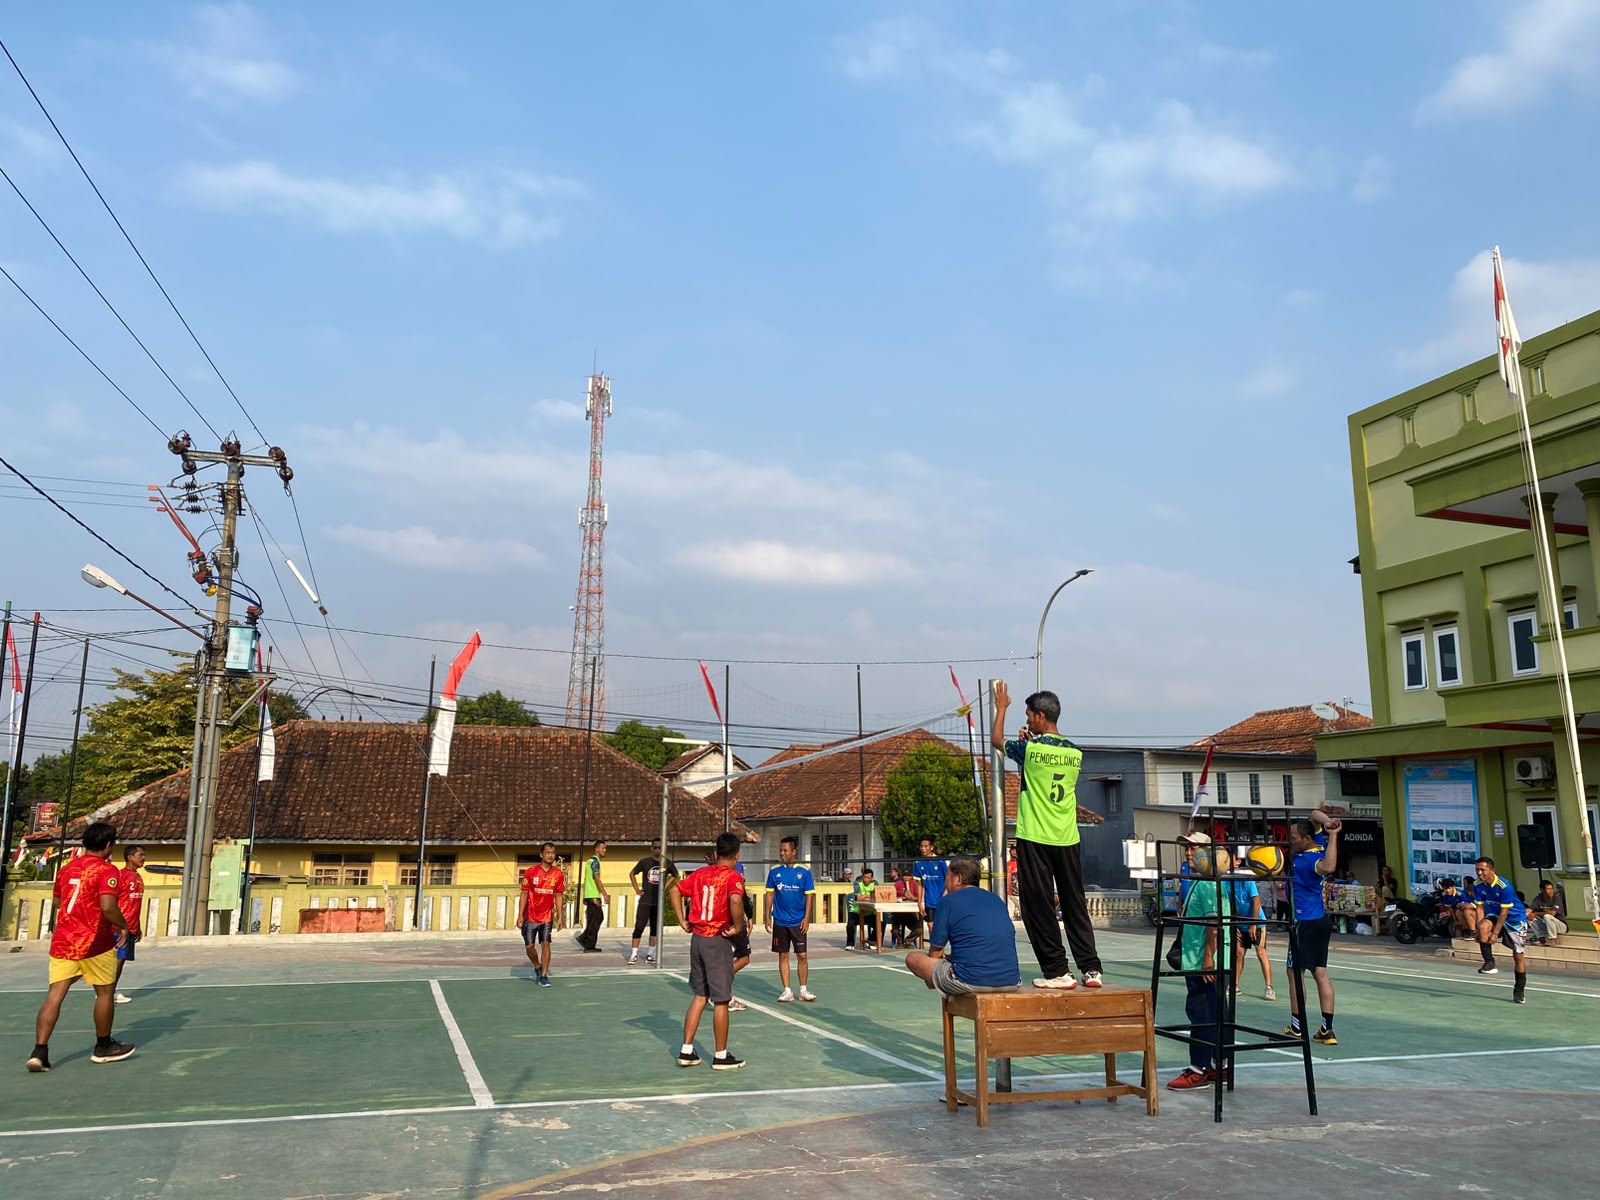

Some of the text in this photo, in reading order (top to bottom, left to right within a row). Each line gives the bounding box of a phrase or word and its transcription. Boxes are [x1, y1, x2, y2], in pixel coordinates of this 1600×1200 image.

[1049, 773, 1065, 803] 5
[1344, 833, 1374, 841] ADINDA
[66, 878, 80, 914] 7
[129, 882, 135, 890] 2
[701, 885, 714, 921] 11
